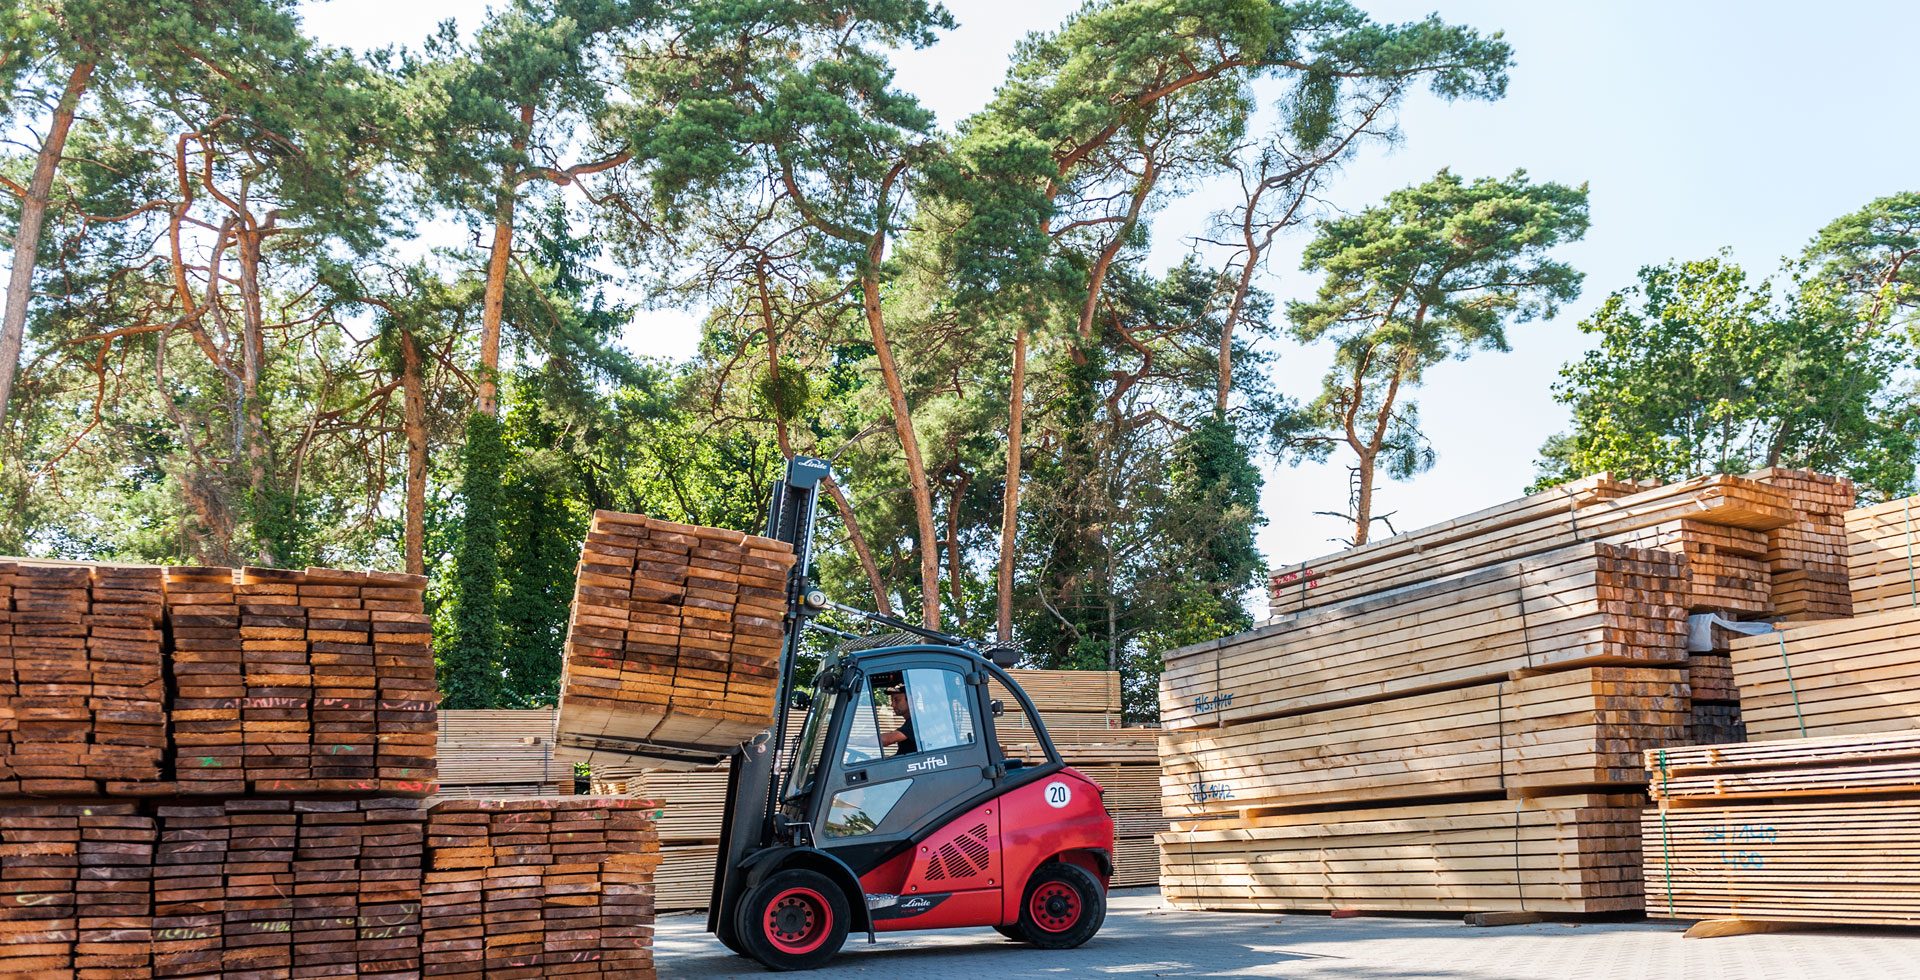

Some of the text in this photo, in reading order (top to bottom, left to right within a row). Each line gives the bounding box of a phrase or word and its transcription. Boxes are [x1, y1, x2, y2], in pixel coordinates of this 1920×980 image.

[797, 458, 828, 470] Linde
[907, 755, 948, 772] suffel
[1050, 786, 1066, 803] 20
[901, 897, 931, 907] Linde
